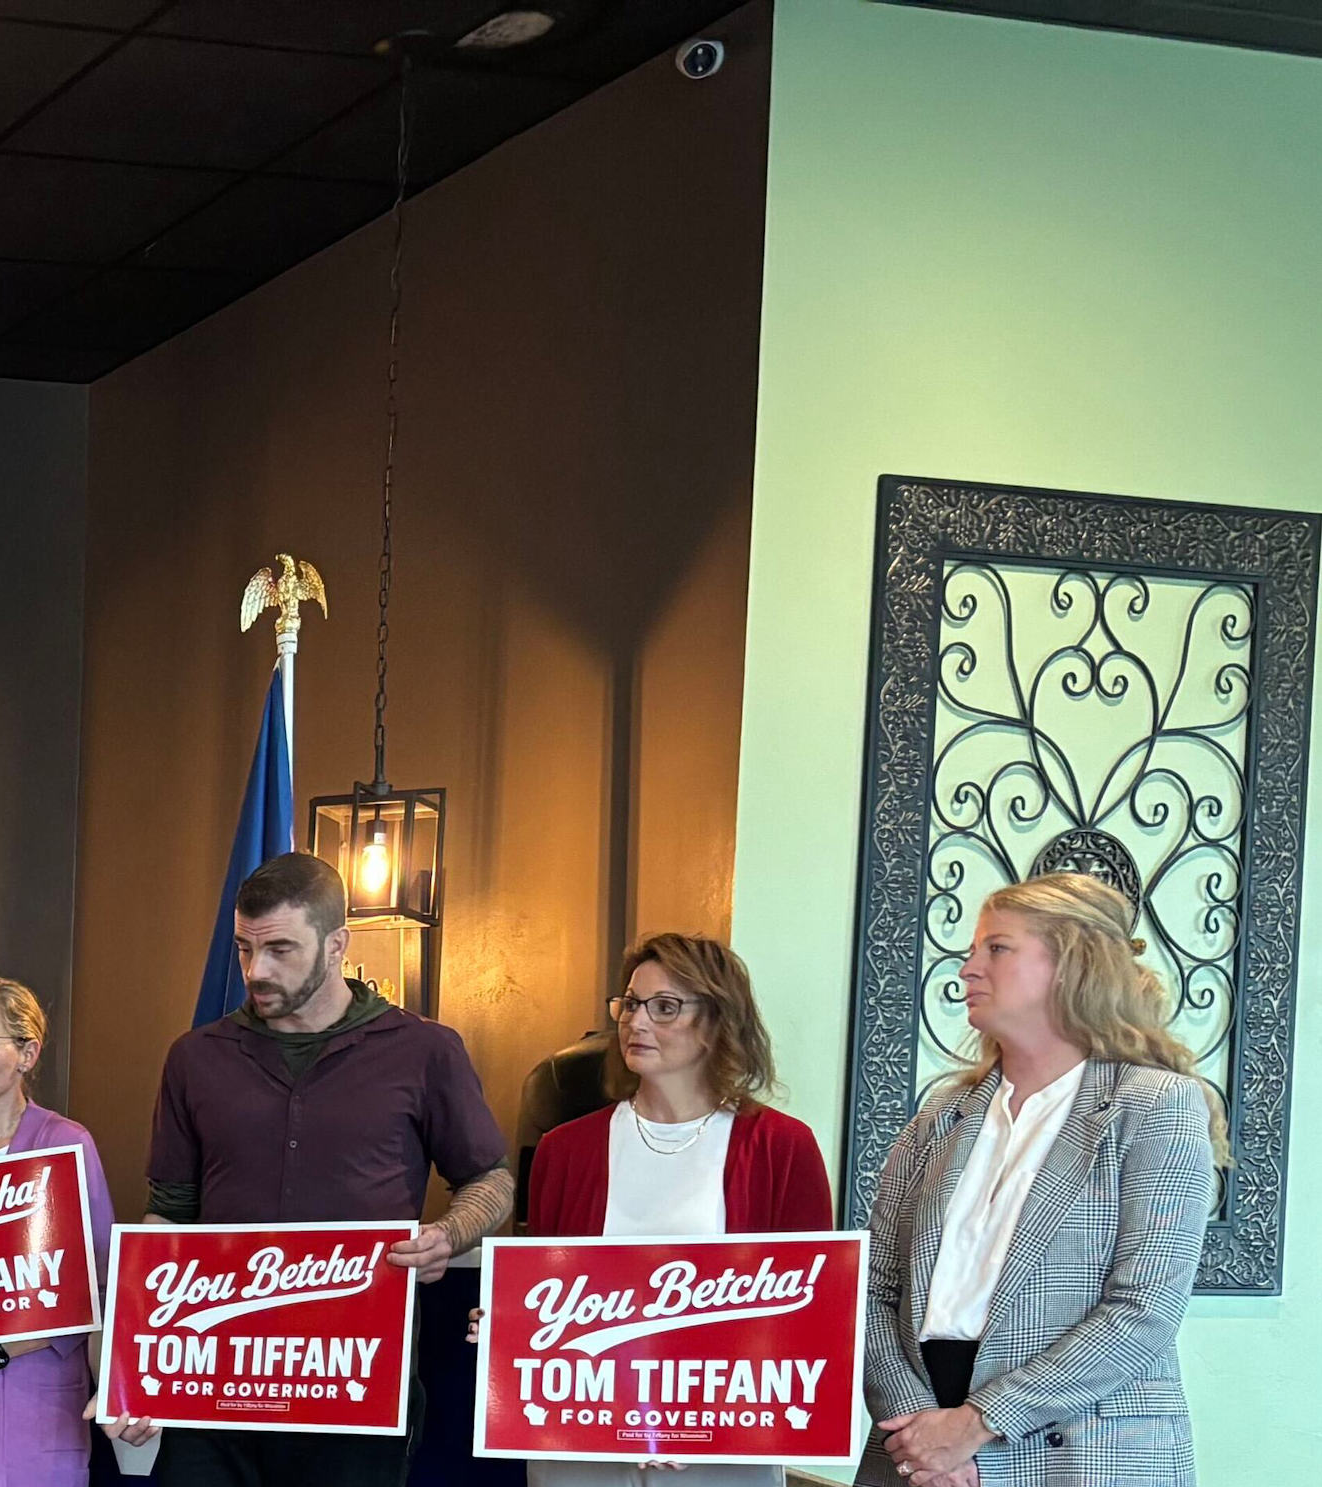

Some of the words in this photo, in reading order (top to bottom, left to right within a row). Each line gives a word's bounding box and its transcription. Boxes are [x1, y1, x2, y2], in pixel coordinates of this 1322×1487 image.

[145, 1259, 236, 1328] You
[241, 1241, 384, 1298] Betcha!
[524, 1275, 635, 1352] You
[643, 1254, 827, 1319] Betcha!
[134, 1334, 218, 1375] TOM
[229, 1336, 382, 1378] TIFFANY
[172, 1380, 214, 1396] FOR
[222, 1381, 338, 1400] GOVERNOR
[513, 1358, 616, 1402] TOM
[630, 1359, 828, 1404] TIFFANY
[561, 1408, 613, 1426] FOR
[625, 1409, 775, 1427] GOVERNOR
